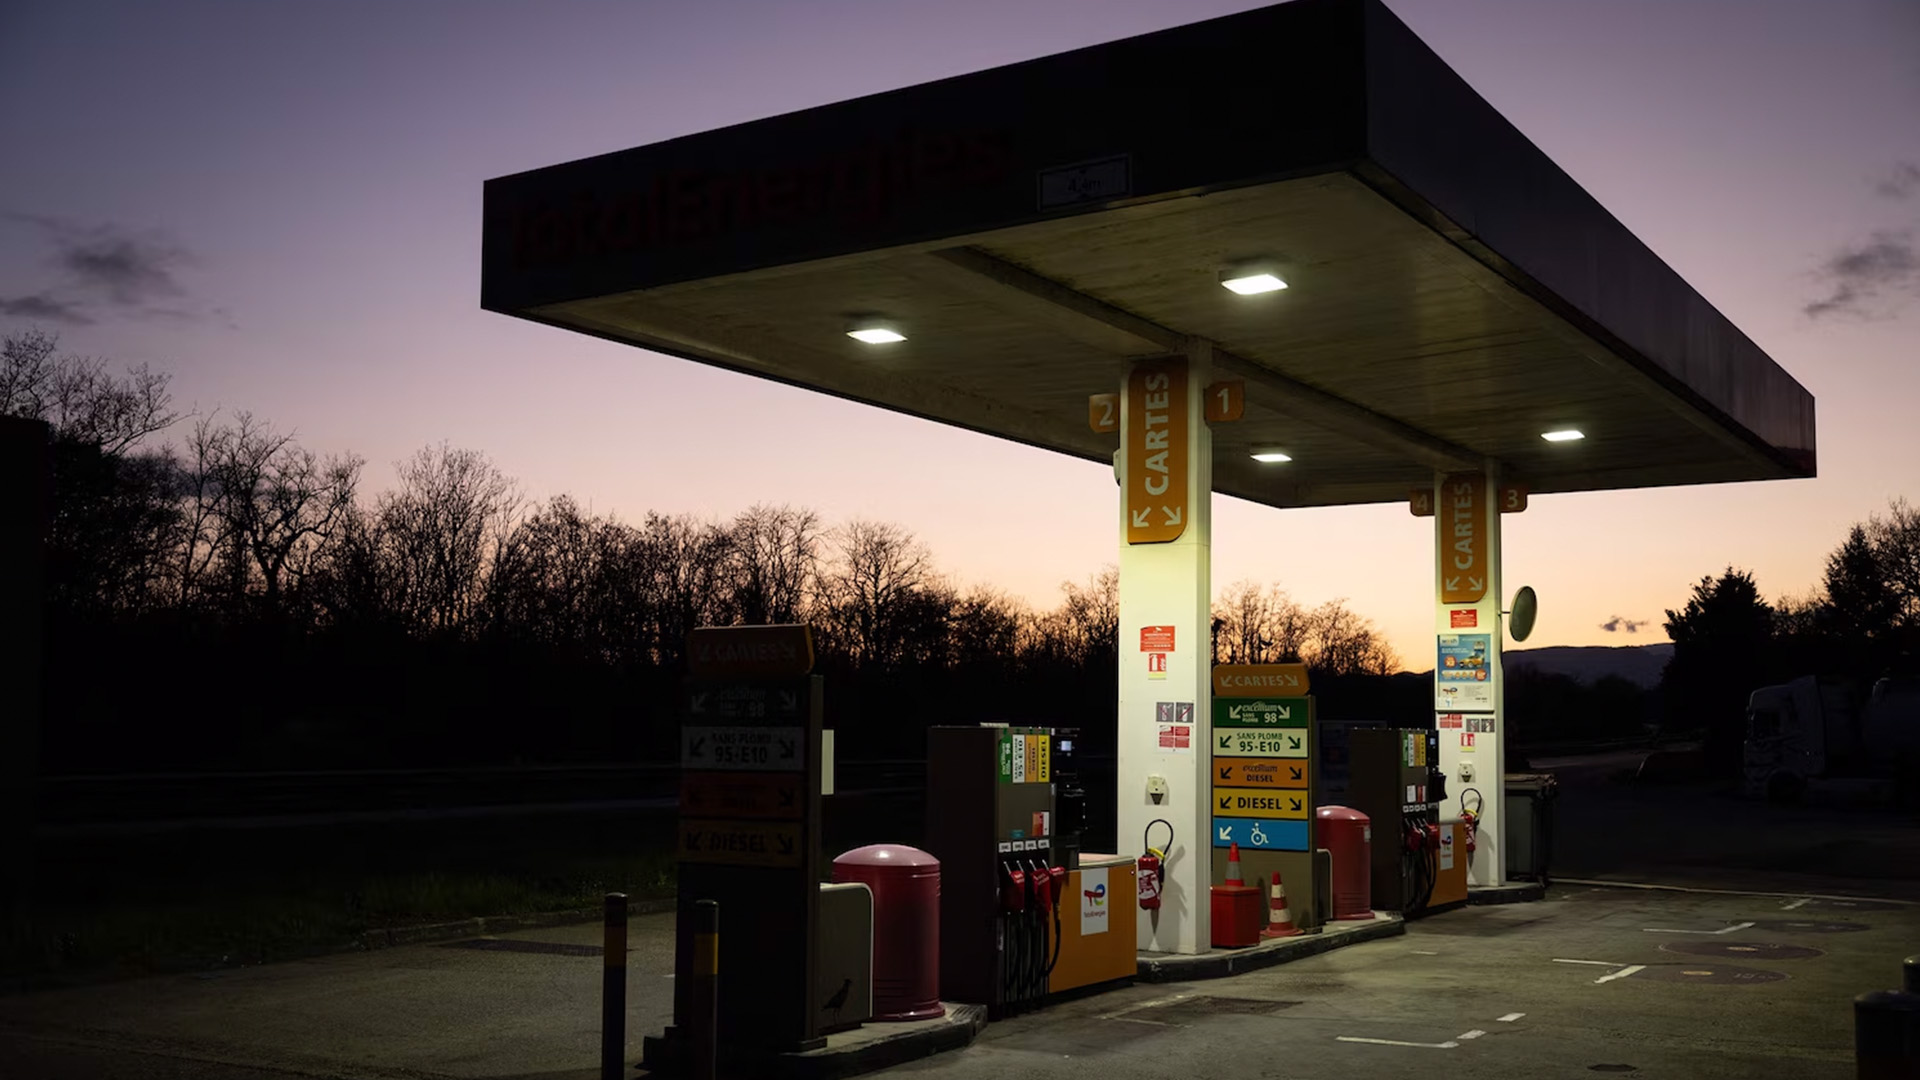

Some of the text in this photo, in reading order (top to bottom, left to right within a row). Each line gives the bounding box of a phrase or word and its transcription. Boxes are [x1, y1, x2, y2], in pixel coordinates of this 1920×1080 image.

[1216, 387, 1229, 414] 1
[1099, 400, 1115, 427] 2
[1144, 372, 1170, 496] CARTES
[1416, 493, 1428, 512] 4
[1506, 489, 1519, 508] 3
[1454, 481, 1474, 571] CARTES
[715, 642, 779, 665] CARTES
[1234, 675, 1284, 687] CARTES
[1263, 712, 1278, 724] 98
[1236, 732, 1283, 741] SANS PLOMB
[1239, 741, 1281, 753] 95-E10
[1246, 774, 1274, 783] DIESEL
[1237, 796, 1282, 810] DIESEL
[709, 831, 767, 854] DIESEL
